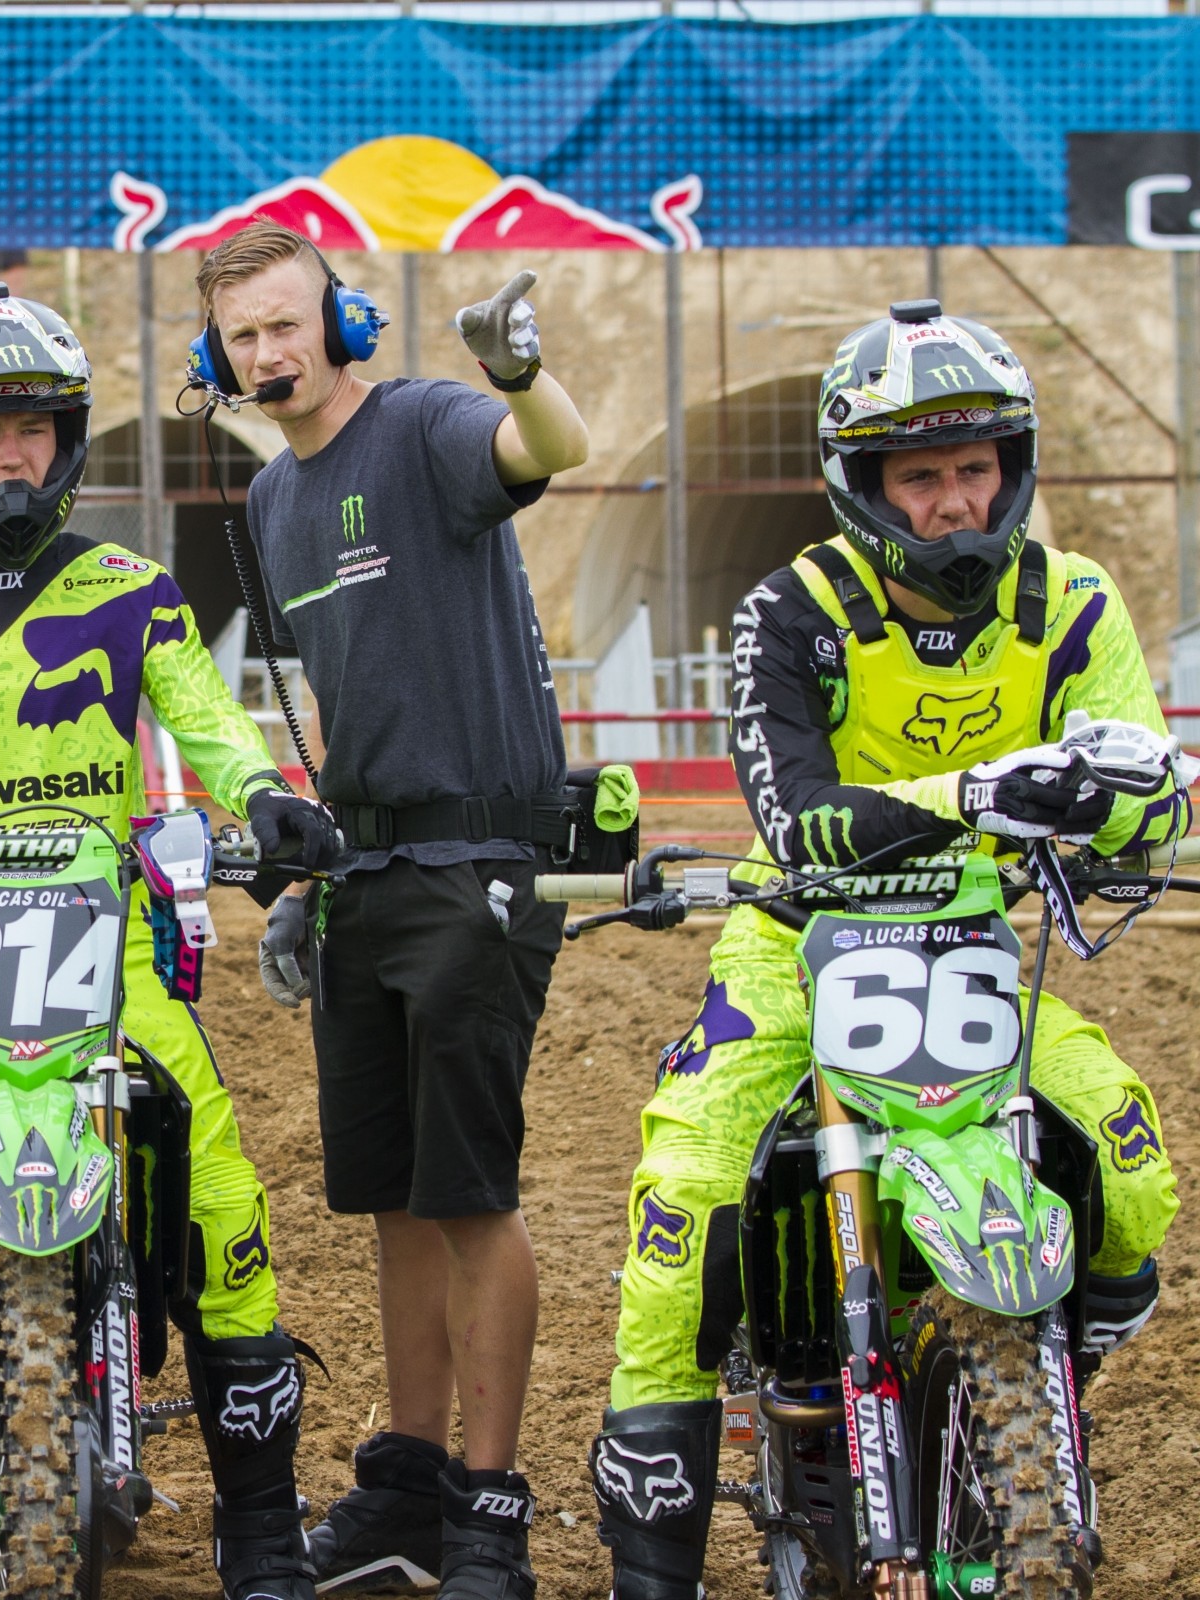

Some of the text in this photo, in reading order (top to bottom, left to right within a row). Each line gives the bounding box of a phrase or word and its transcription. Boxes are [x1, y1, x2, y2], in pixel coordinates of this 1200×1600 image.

[906, 329, 951, 342] BELL
[853, 426, 898, 436] CIRCUIT
[107, 556, 143, 571] BELL
[338, 545, 379, 562] MONSTER
[74, 577, 128, 587] SCOTT
[339, 566, 387, 587] Kawasaki
[915, 630, 956, 651] FOX
[964, 780, 999, 811] FOX
[39, 891, 68, 908] OIL
[1098, 885, 1149, 897] ARC
[864, 925, 963, 946] LUCAS OIL
[811, 947, 1021, 1076] 66
[22, 1165, 50, 1174] BELL
[906, 1154, 963, 1213] CIRCUIT
[836, 1190, 860, 1247] PRO
[987, 1221, 1018, 1230] BELL
[843, 1301, 868, 1317] 360
[911, 1321, 936, 1376] DUNLOP
[106, 1301, 133, 1471] DUNLOP
[726, 1413, 752, 1429] ENTHAL
[842, 1369, 862, 1478] BRAKING
[856, 1392, 892, 1540] UNLOP
[471, 1491, 525, 1519] FOX
[970, 1576, 996, 1595] 66
